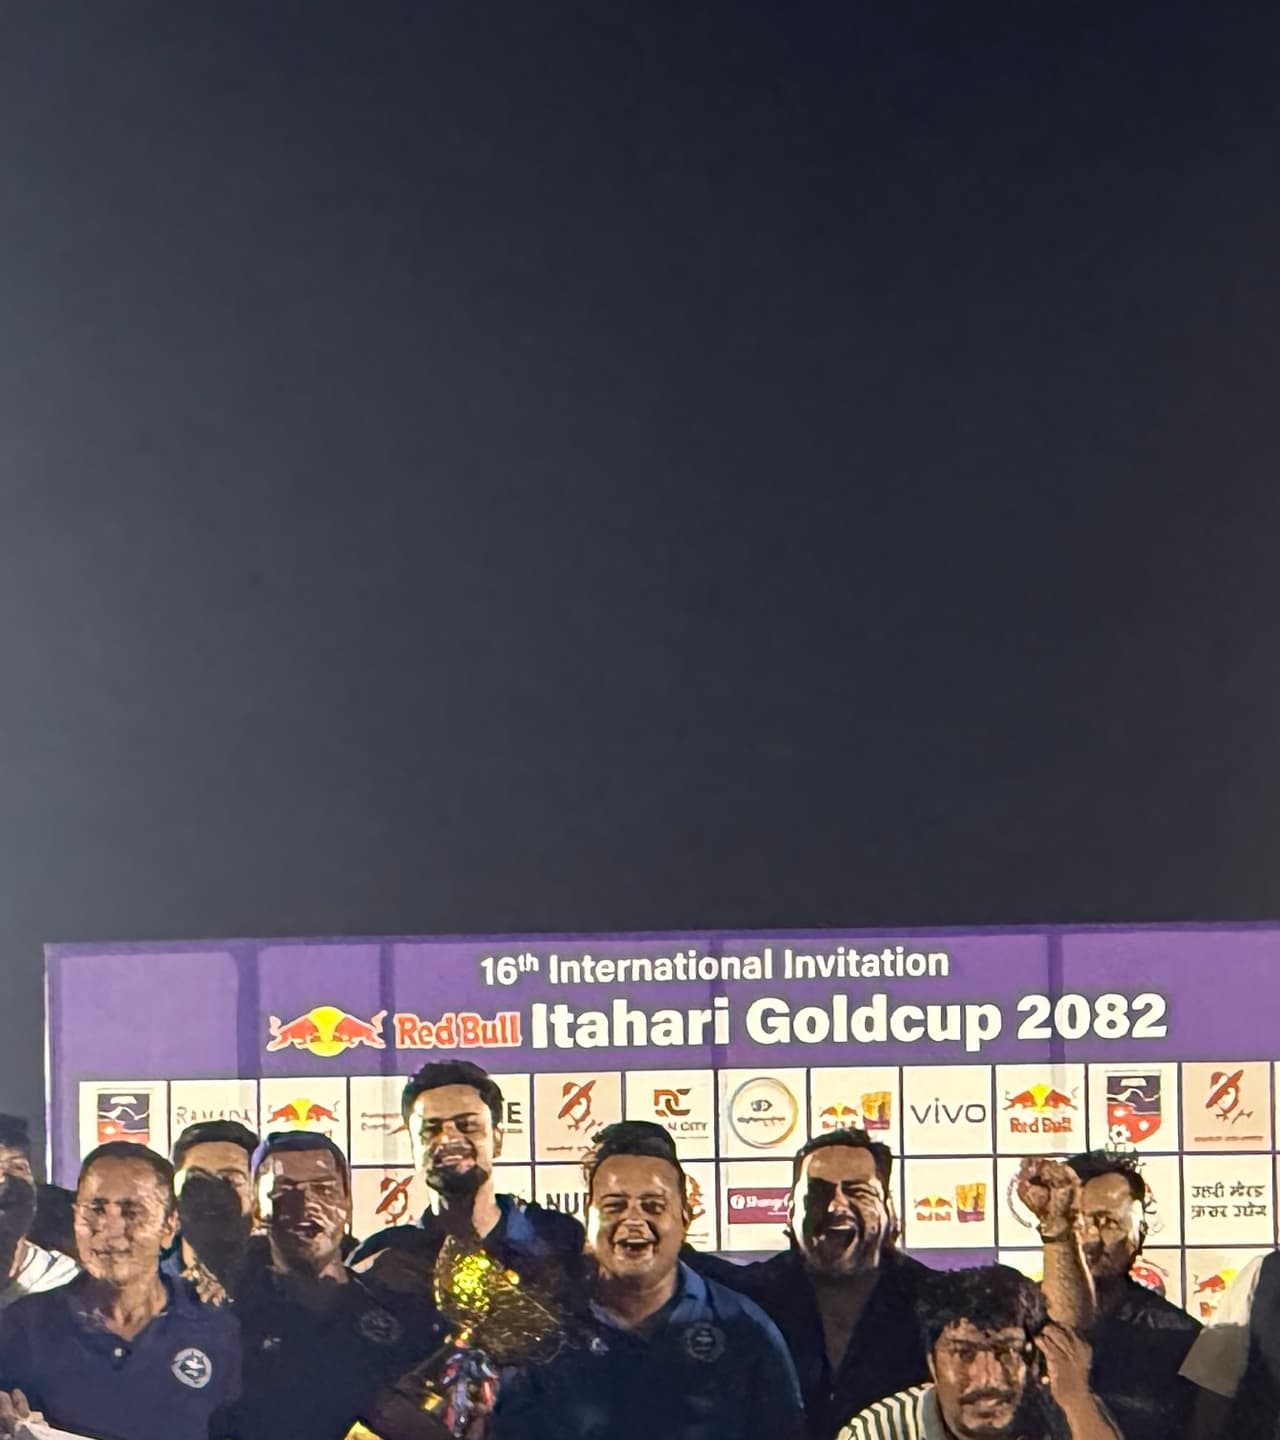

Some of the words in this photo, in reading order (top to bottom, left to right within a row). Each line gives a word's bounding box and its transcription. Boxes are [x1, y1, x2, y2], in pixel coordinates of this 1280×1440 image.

[480, 952, 539, 986] 16th
[549, 948, 772, 984] International
[784, 945, 949, 981] Invitation
[394, 1013, 456, 1048] Red
[457, 1012, 522, 1047] Bull
[531, 997, 730, 1049] Itahari
[745, 993, 1002, 1051] Goldcup
[1017, 993, 1168, 1040] 2082
[910, 1098, 986, 1124] vivo
